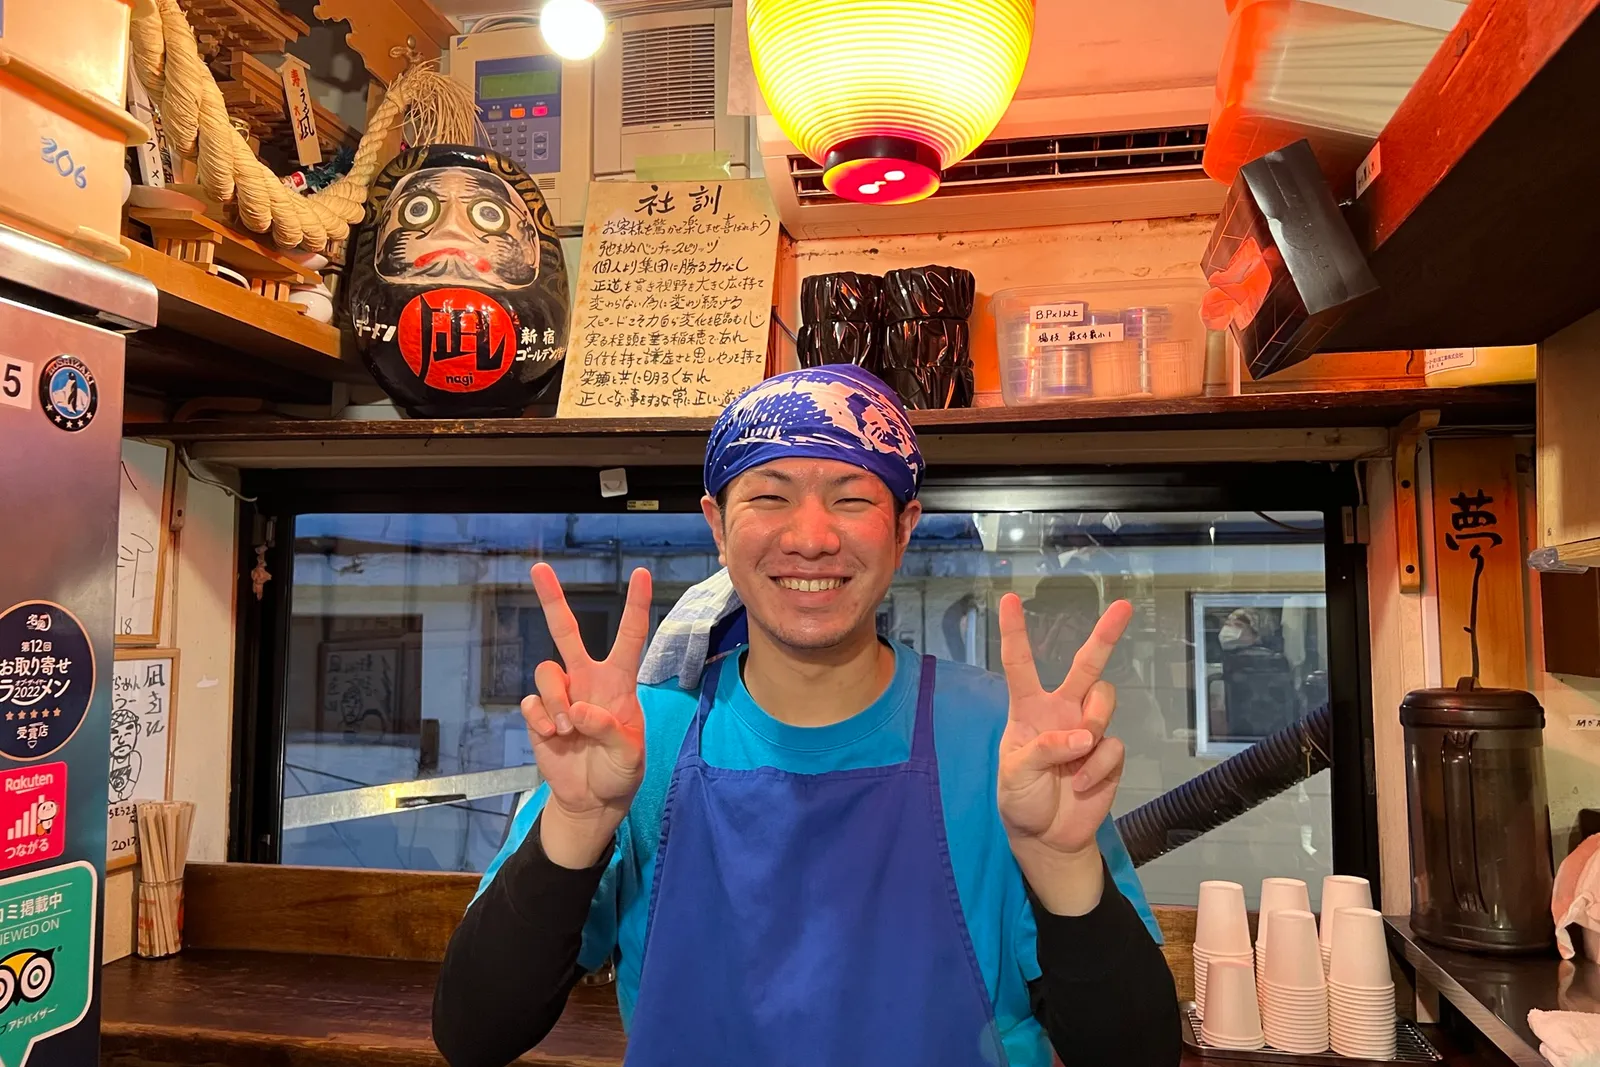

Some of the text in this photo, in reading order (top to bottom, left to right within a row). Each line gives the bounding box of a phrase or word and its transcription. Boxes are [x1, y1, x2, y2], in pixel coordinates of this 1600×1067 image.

[634, 185, 722, 216] 社訓
[592, 257, 749, 275] 個人より集団に勝る力なし
[590, 277, 764, 294] 正道を貫き視野を大きく広く持て
[521, 327, 555, 345] 新宿
[2, 363, 21, 397] 5
[48, 358, 95, 386] HOSHIZAKI
[445, 373, 475, 386] nagi
[580, 367, 711, 387] 笑顔と共に明るくあれ
[21, 639, 52, 653] 第12回
[0, 656, 72, 677] お取り寄せ
[13, 685, 41, 699] 2022
[16, 724, 49, 741] 受賞店
[5, 773, 54, 793] Rakuten
[5, 838, 49, 859] つながる
[41, 917, 59, 933] ON
